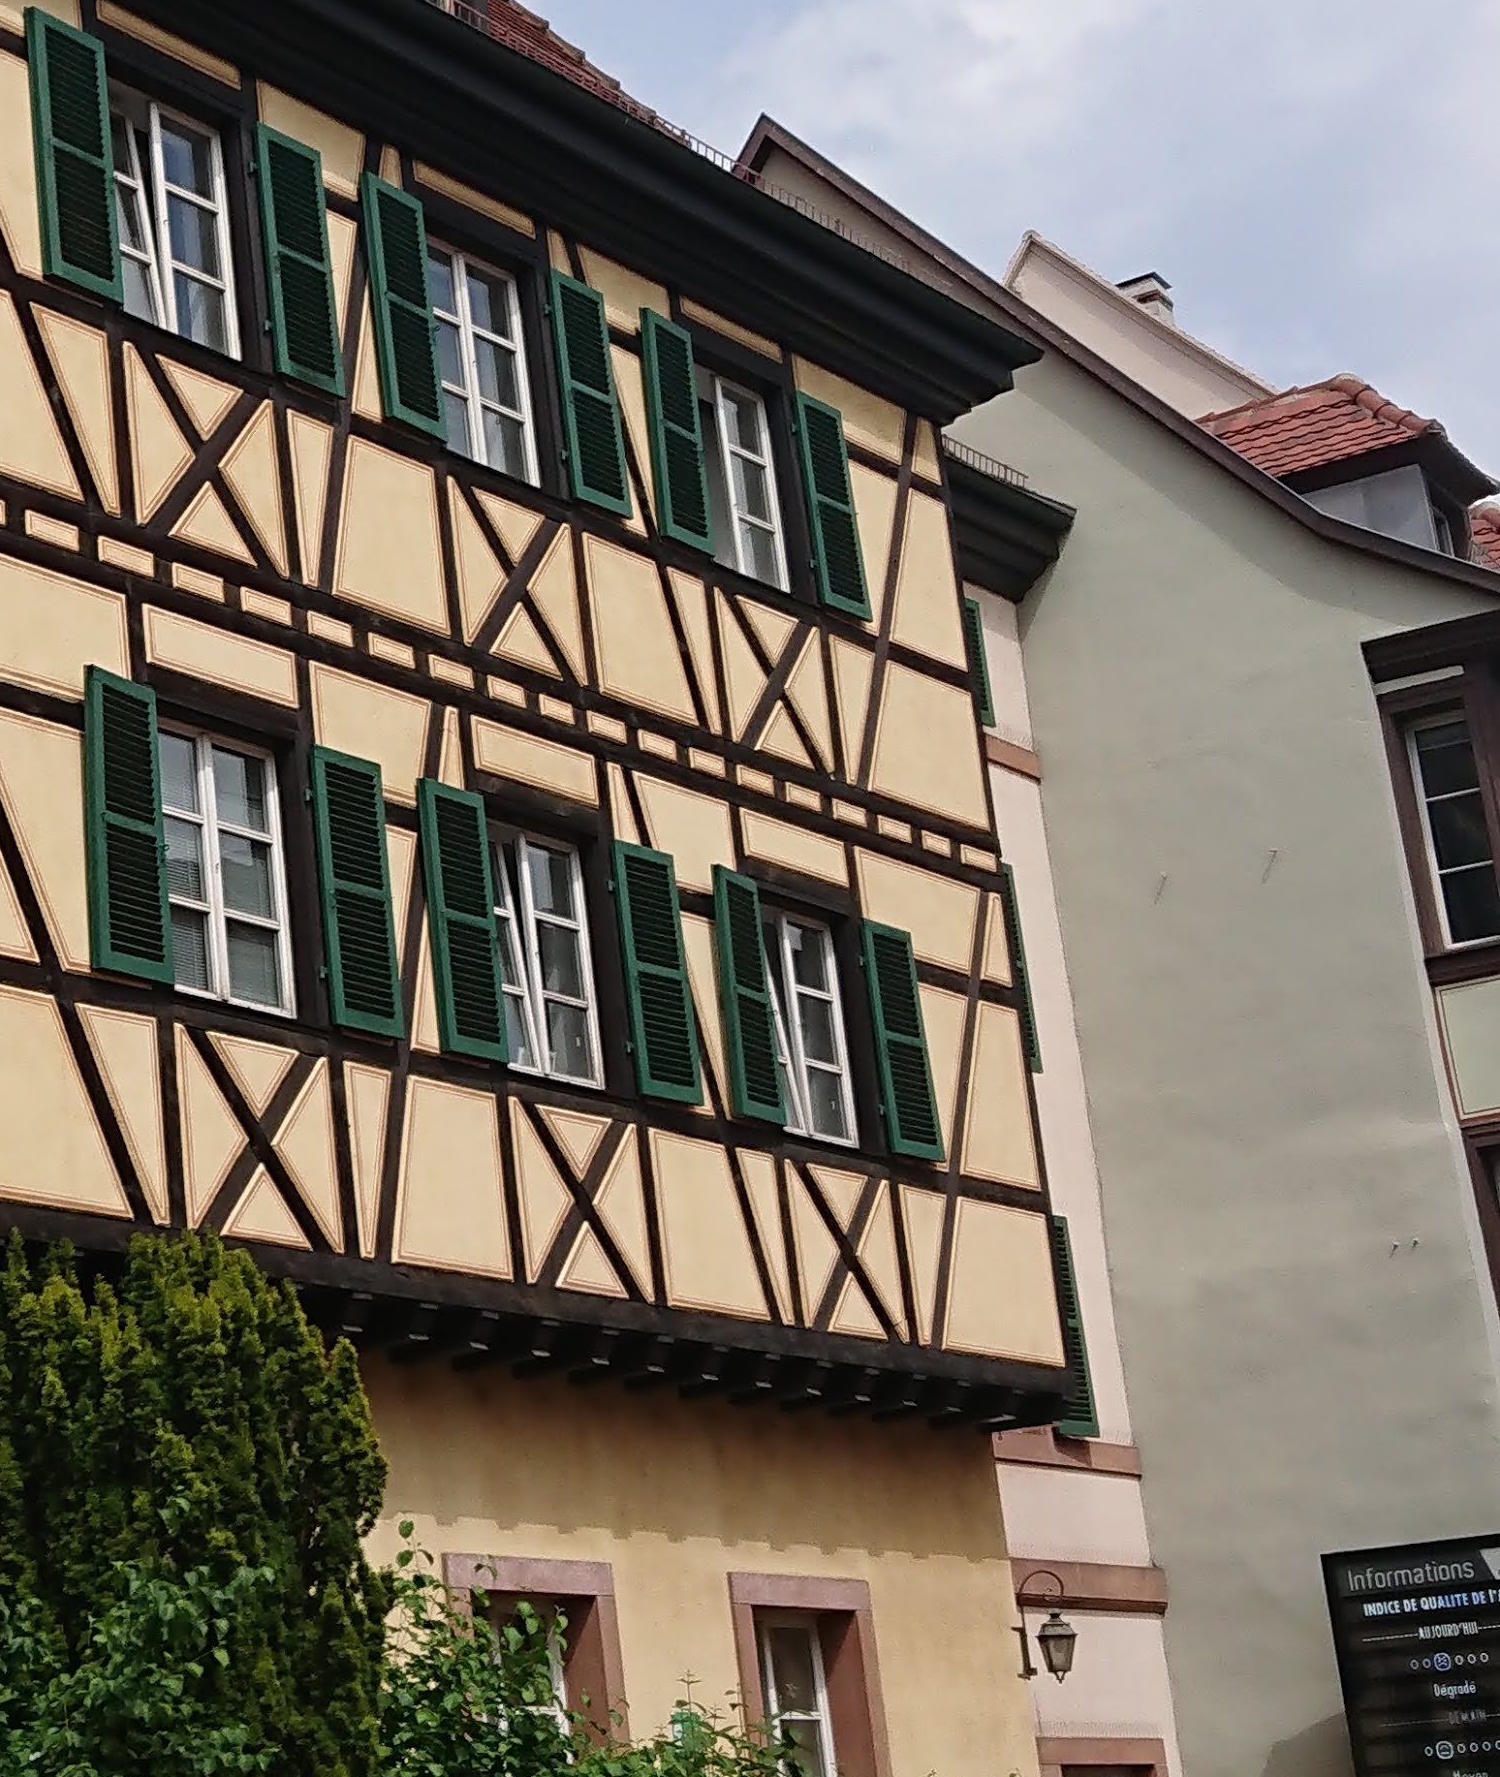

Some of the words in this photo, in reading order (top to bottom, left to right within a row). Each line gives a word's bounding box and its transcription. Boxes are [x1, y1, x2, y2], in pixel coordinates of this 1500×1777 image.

[1348, 1561, 1475, 1592] Informations
[1363, 1599, 1400, 1617] INDICE
[1403, 1598, 1418, 1613] DE
[1420, 1593, 1469, 1610] QUALITE
[1471, 1591, 1486, 1605] DE
[1418, 1622, 1478, 1640] AUJOURD'HUI
[1433, 1682, 1476, 1699] Dégradé
